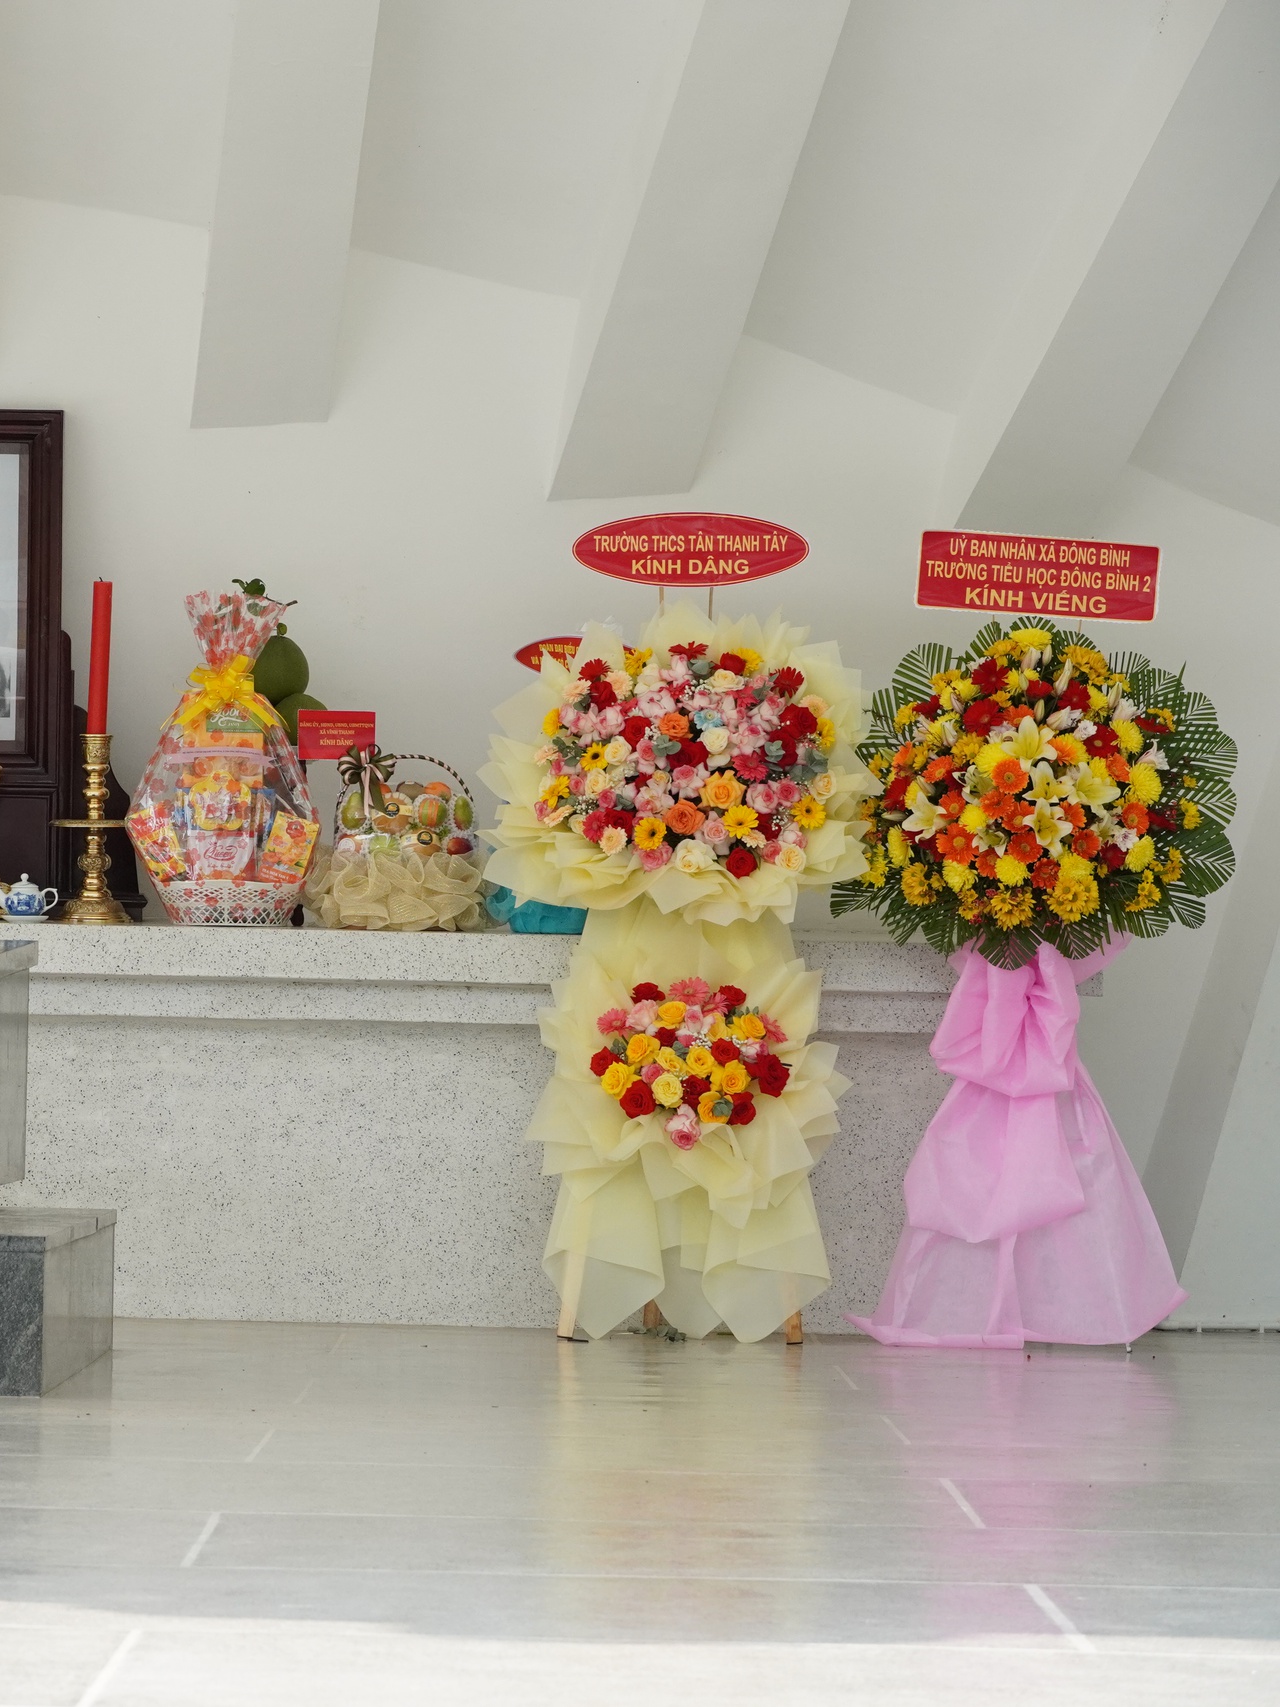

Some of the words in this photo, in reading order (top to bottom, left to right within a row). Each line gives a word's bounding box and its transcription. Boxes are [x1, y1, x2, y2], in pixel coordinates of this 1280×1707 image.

[593, 531, 649, 553] TRƯỜNG
[652, 535, 685, 553] THCS
[688, 531, 714, 552] TÂN
[717, 535, 760, 557] THẠNH
[763, 531, 788, 552] TÂY
[950, 534, 968, 556] UỶ
[970, 540, 997, 559] BAN
[1000, 538, 1036, 561] NHÂN
[1038, 541, 1056, 562] XÃ
[1059, 542, 1097, 565] ĐÔNG
[1100, 545, 1130, 567] BÌNH
[631, 555, 681, 575] KÍNH
[688, 555, 750, 575] DÂNG
[926, 558, 988, 581] TRƯỜNG
[991, 562, 1023, 583] TIỂU
[1026, 567, 1057, 589] HỌC
[1060, 566, 1102, 589] ĐÔNG
[1105, 569, 1140, 592] BÌNH
[1142, 575, 1151, 593] 2
[965, 584, 1024, 608] KÍNH
[1031, 590, 1107, 614] VIẾNG
[319, 737, 335, 746] KÍNH
[336, 737, 354, 746] DÂNG
